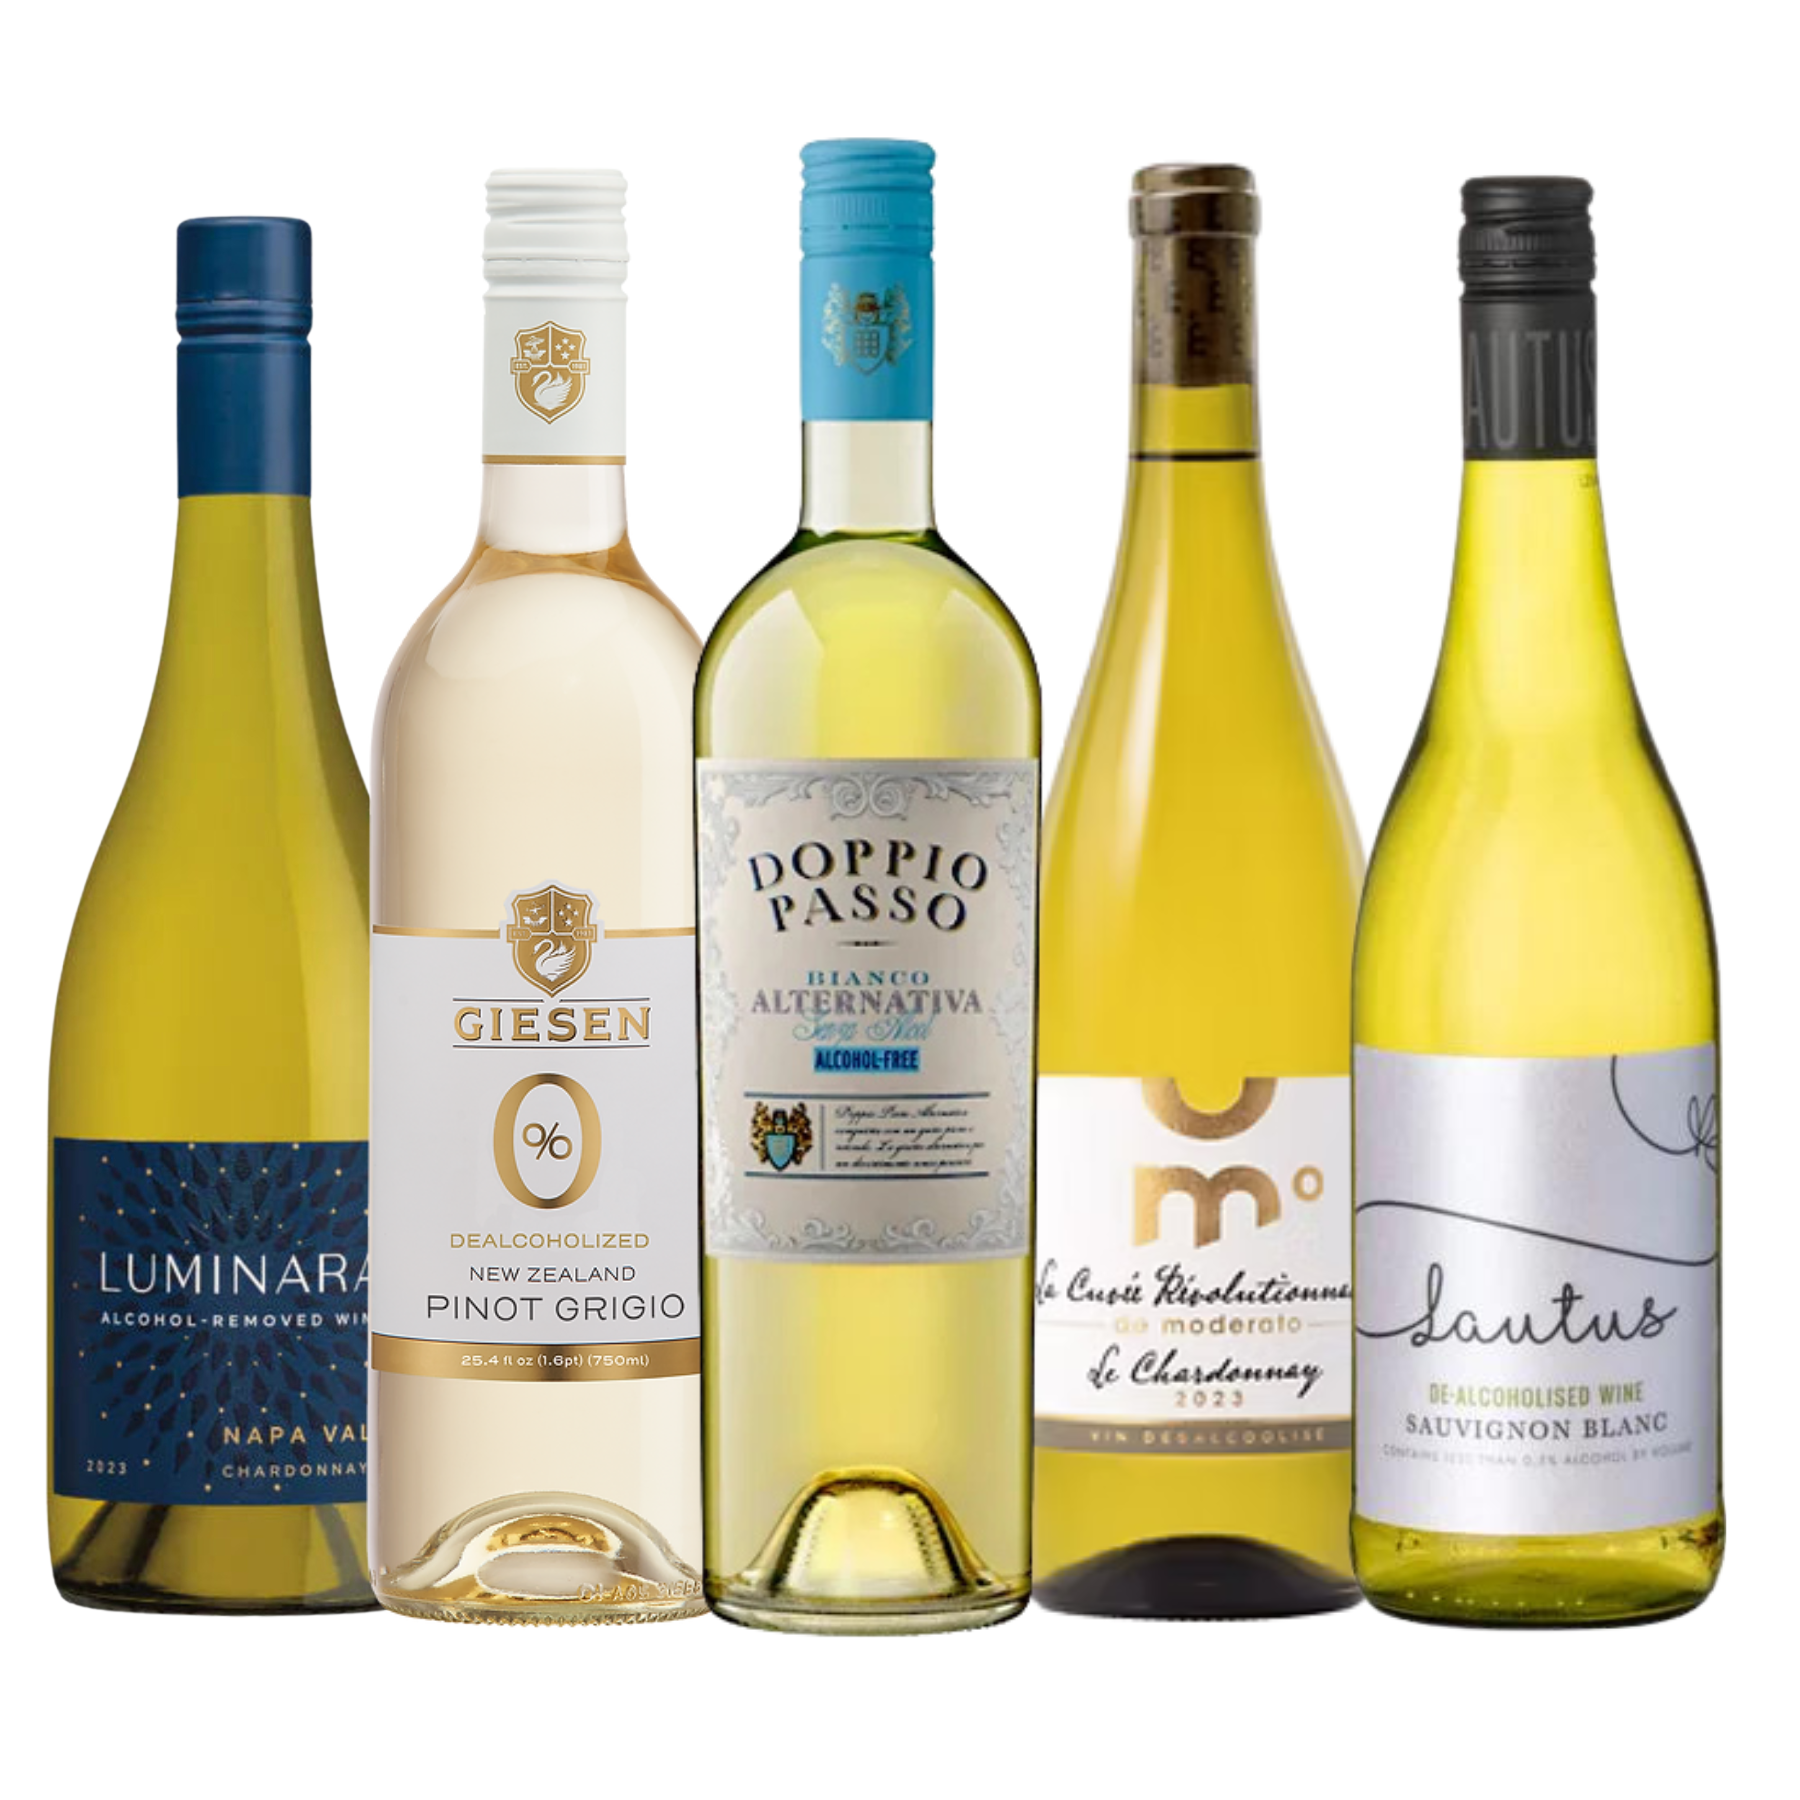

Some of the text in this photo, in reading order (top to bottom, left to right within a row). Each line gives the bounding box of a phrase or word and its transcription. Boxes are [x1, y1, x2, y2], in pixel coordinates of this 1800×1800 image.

[748, 839, 988, 892] DOPPIO
[770, 883, 967, 932] PASSO
[807, 970, 930, 986] BIANCO
[750, 989, 984, 1015] ALTERNATIVA
[454, 1006, 651, 1042] GIESEN
[815, 1049, 919, 1069] ALCOHOL-FREE
[450, 1233, 650, 1249] DEALCOHOLIZED
[470, 1265, 636, 1283] NEW ZEALAND
[427, 1293, 685, 1322] PINOT GRIGIO
[101, 1311, 369, 1328] ALCOHOL-REMOVED WIN
[1161, 1314, 1302, 1335] moderato
[461, 1354, 650, 1369] 25.4 fl oz (1.6pt) (750ml)
[1087, 1344, 1324, 1399] Le Chardonnay
[1175, 1390, 1244, 1407] 2023
[1429, 1381, 1644, 1409] DE-ALCOHOLISED WINE
[223, 1424, 368, 1444] NAPA VAL
[1406, 1412, 1668, 1440] SAUVIGNON BLANC
[86, 1458, 127, 1475] 2023
[222, 1461, 367, 1478] CHARDONNAY
